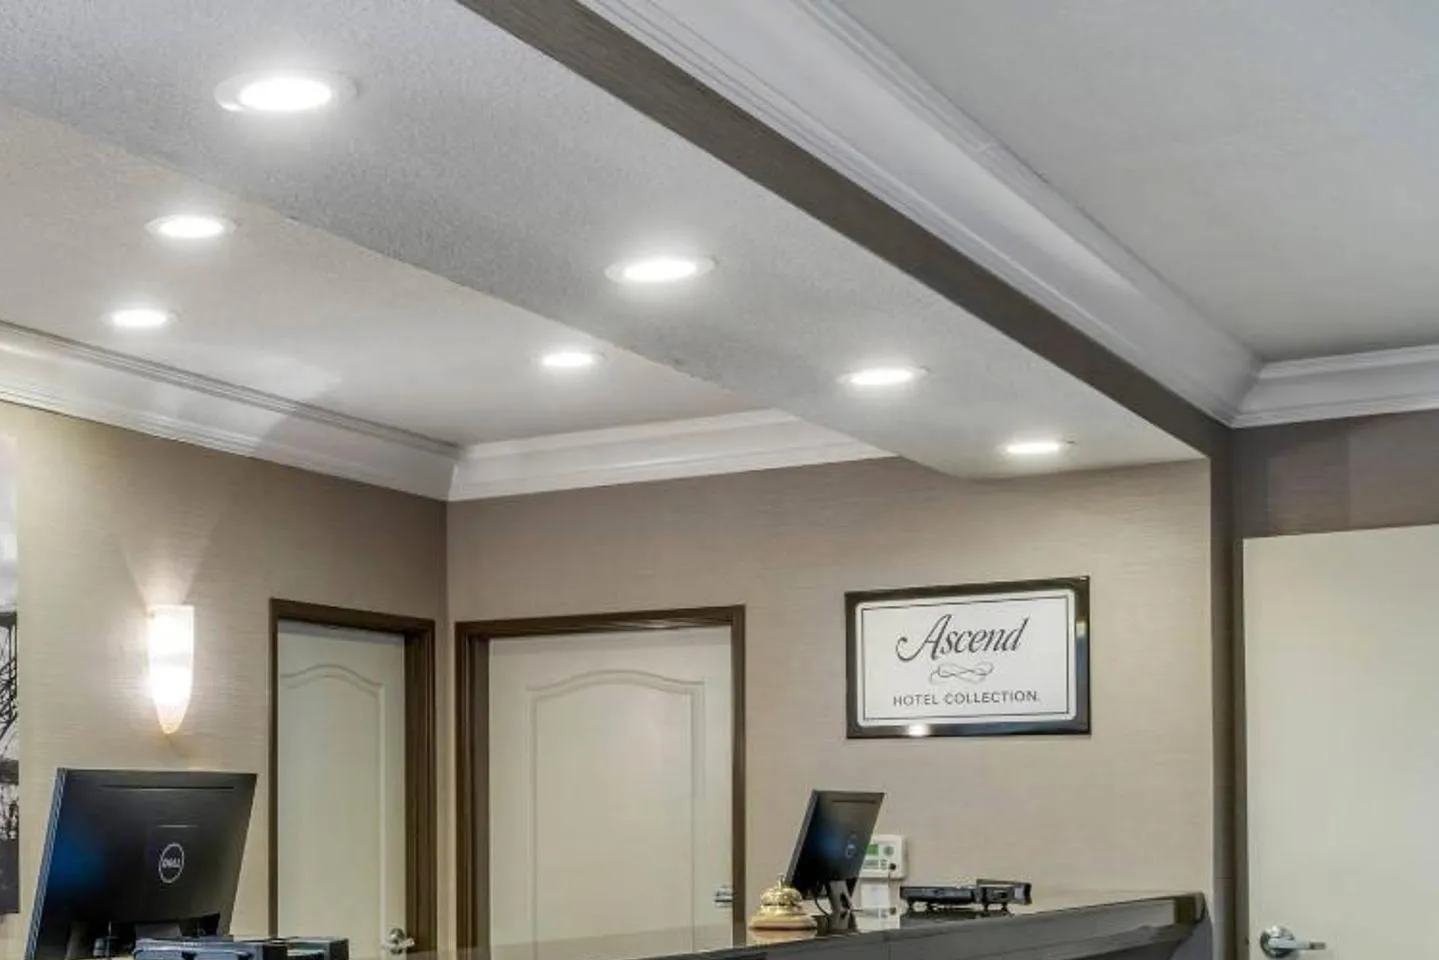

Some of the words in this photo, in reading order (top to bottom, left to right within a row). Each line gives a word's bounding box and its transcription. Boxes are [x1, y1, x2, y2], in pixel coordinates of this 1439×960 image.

[895, 613, 1030, 662] Ascend
[893, 693, 939, 706] HOTEL
[943, 690, 1038, 705] COLLECTION
